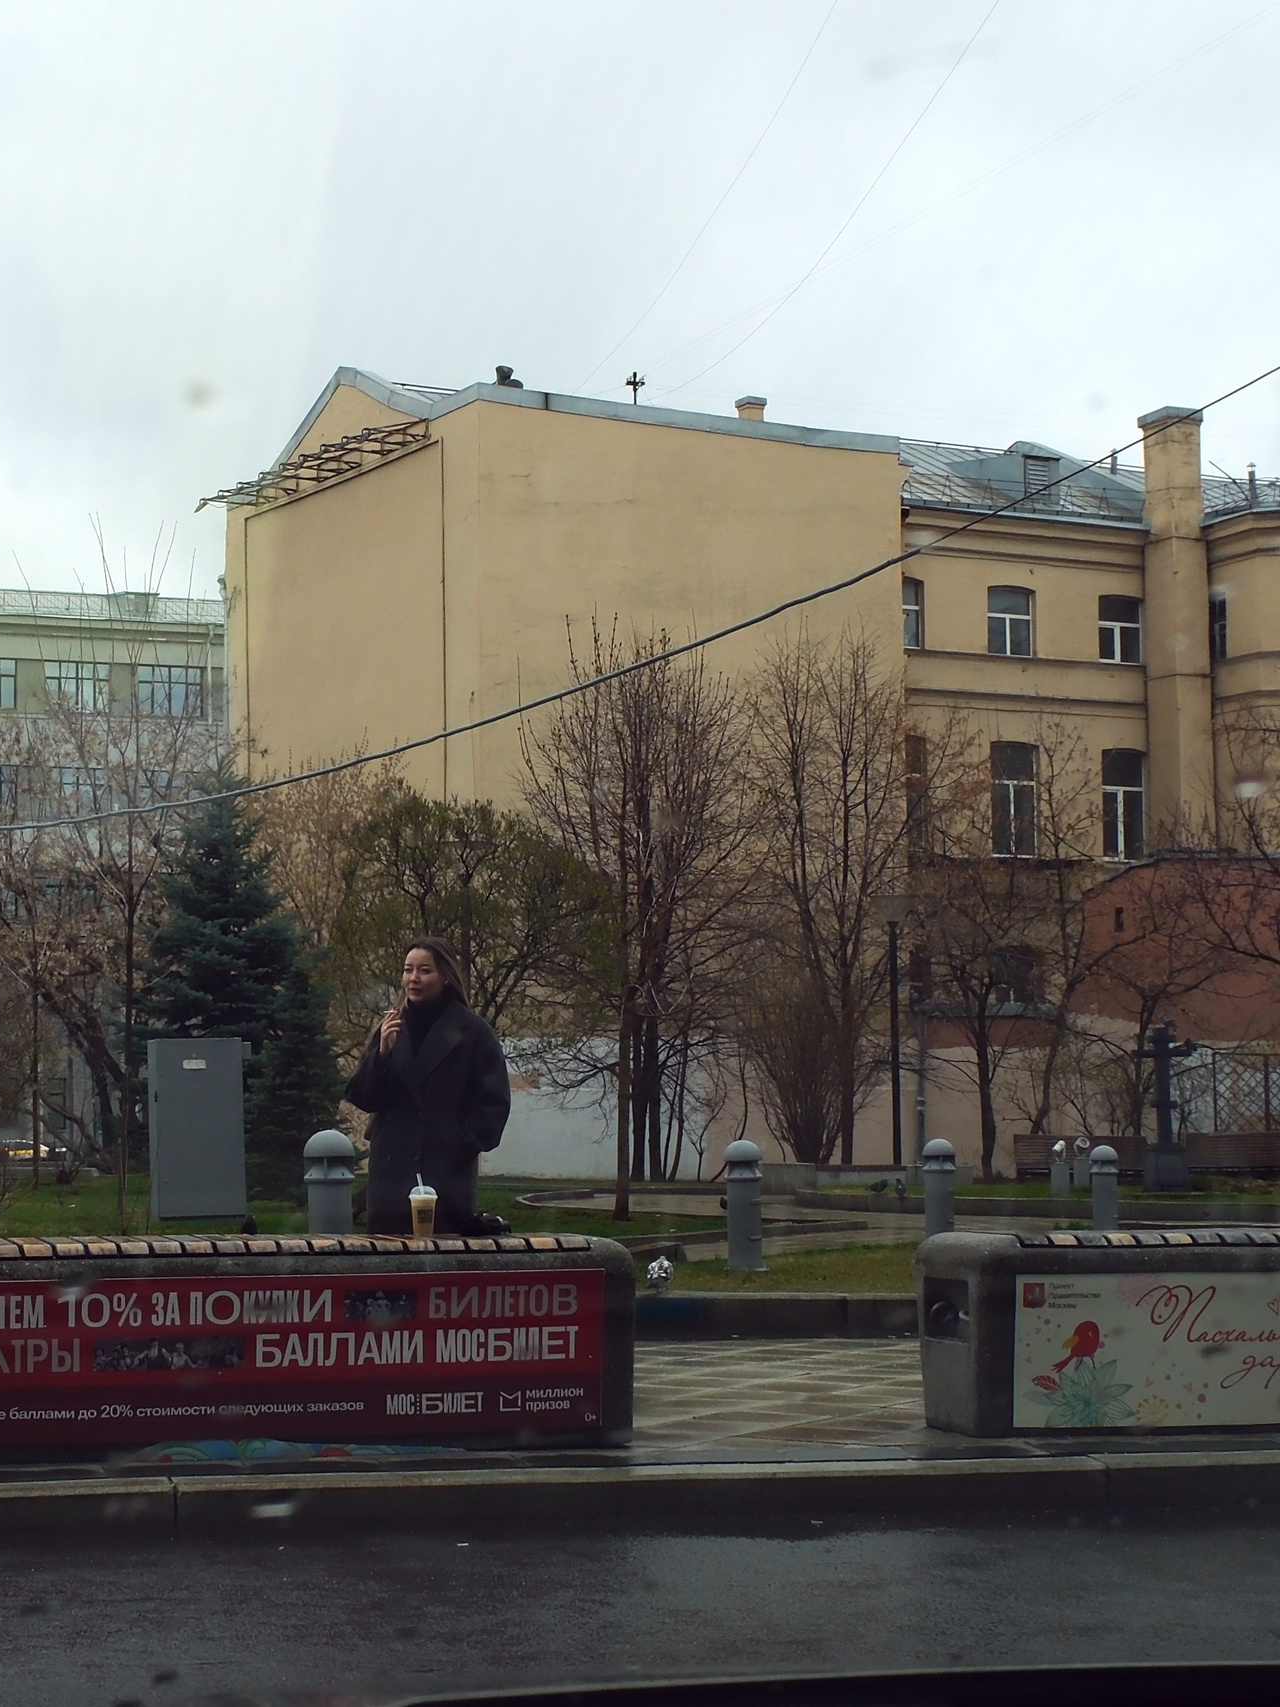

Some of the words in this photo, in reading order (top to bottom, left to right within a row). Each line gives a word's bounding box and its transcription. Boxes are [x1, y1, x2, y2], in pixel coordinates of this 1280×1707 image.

[57, 1292, 142, 1328] 10%
[151, 1292, 181, 1326] ЗА
[189, 1290, 332, 1325] ПОКУПКИ
[428, 1284, 578, 1319] БИЛЕТОВ
[255, 1330, 424, 1368] БАЛЛАМИ
[436, 1325, 579, 1363] МОСБИЛЕТ
[9, 1406, 75, 1420] баллами
[78, 1407, 97, 1421] до
[100, 1404, 134, 1418] 20%
[136, 1404, 216, 1418] стоимости
[219, 1402, 304, 1417] следующих
[306, 1401, 365, 1413] заказов
[525, 1399, 570, 1413] призов
[584, 1412, 597, 1422] 0+
